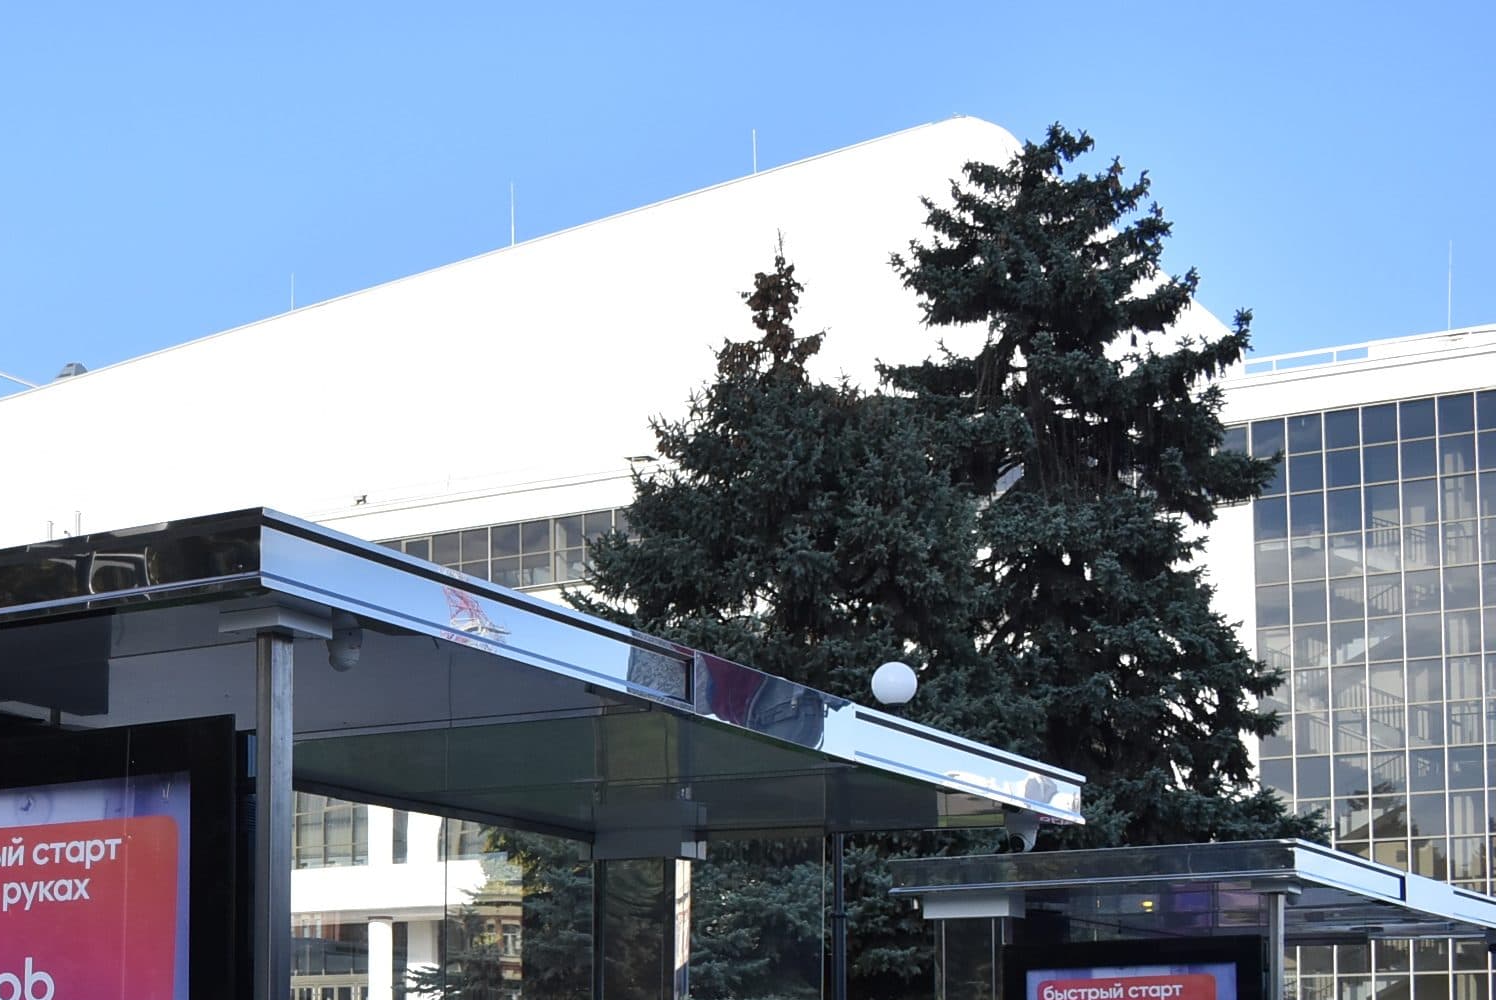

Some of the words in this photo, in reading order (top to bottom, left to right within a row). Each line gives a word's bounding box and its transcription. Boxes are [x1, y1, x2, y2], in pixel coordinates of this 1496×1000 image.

[32, 837, 123, 870] старт
[3, 878, 91, 912] руках
[1128, 984, 1183, 1000] старт
